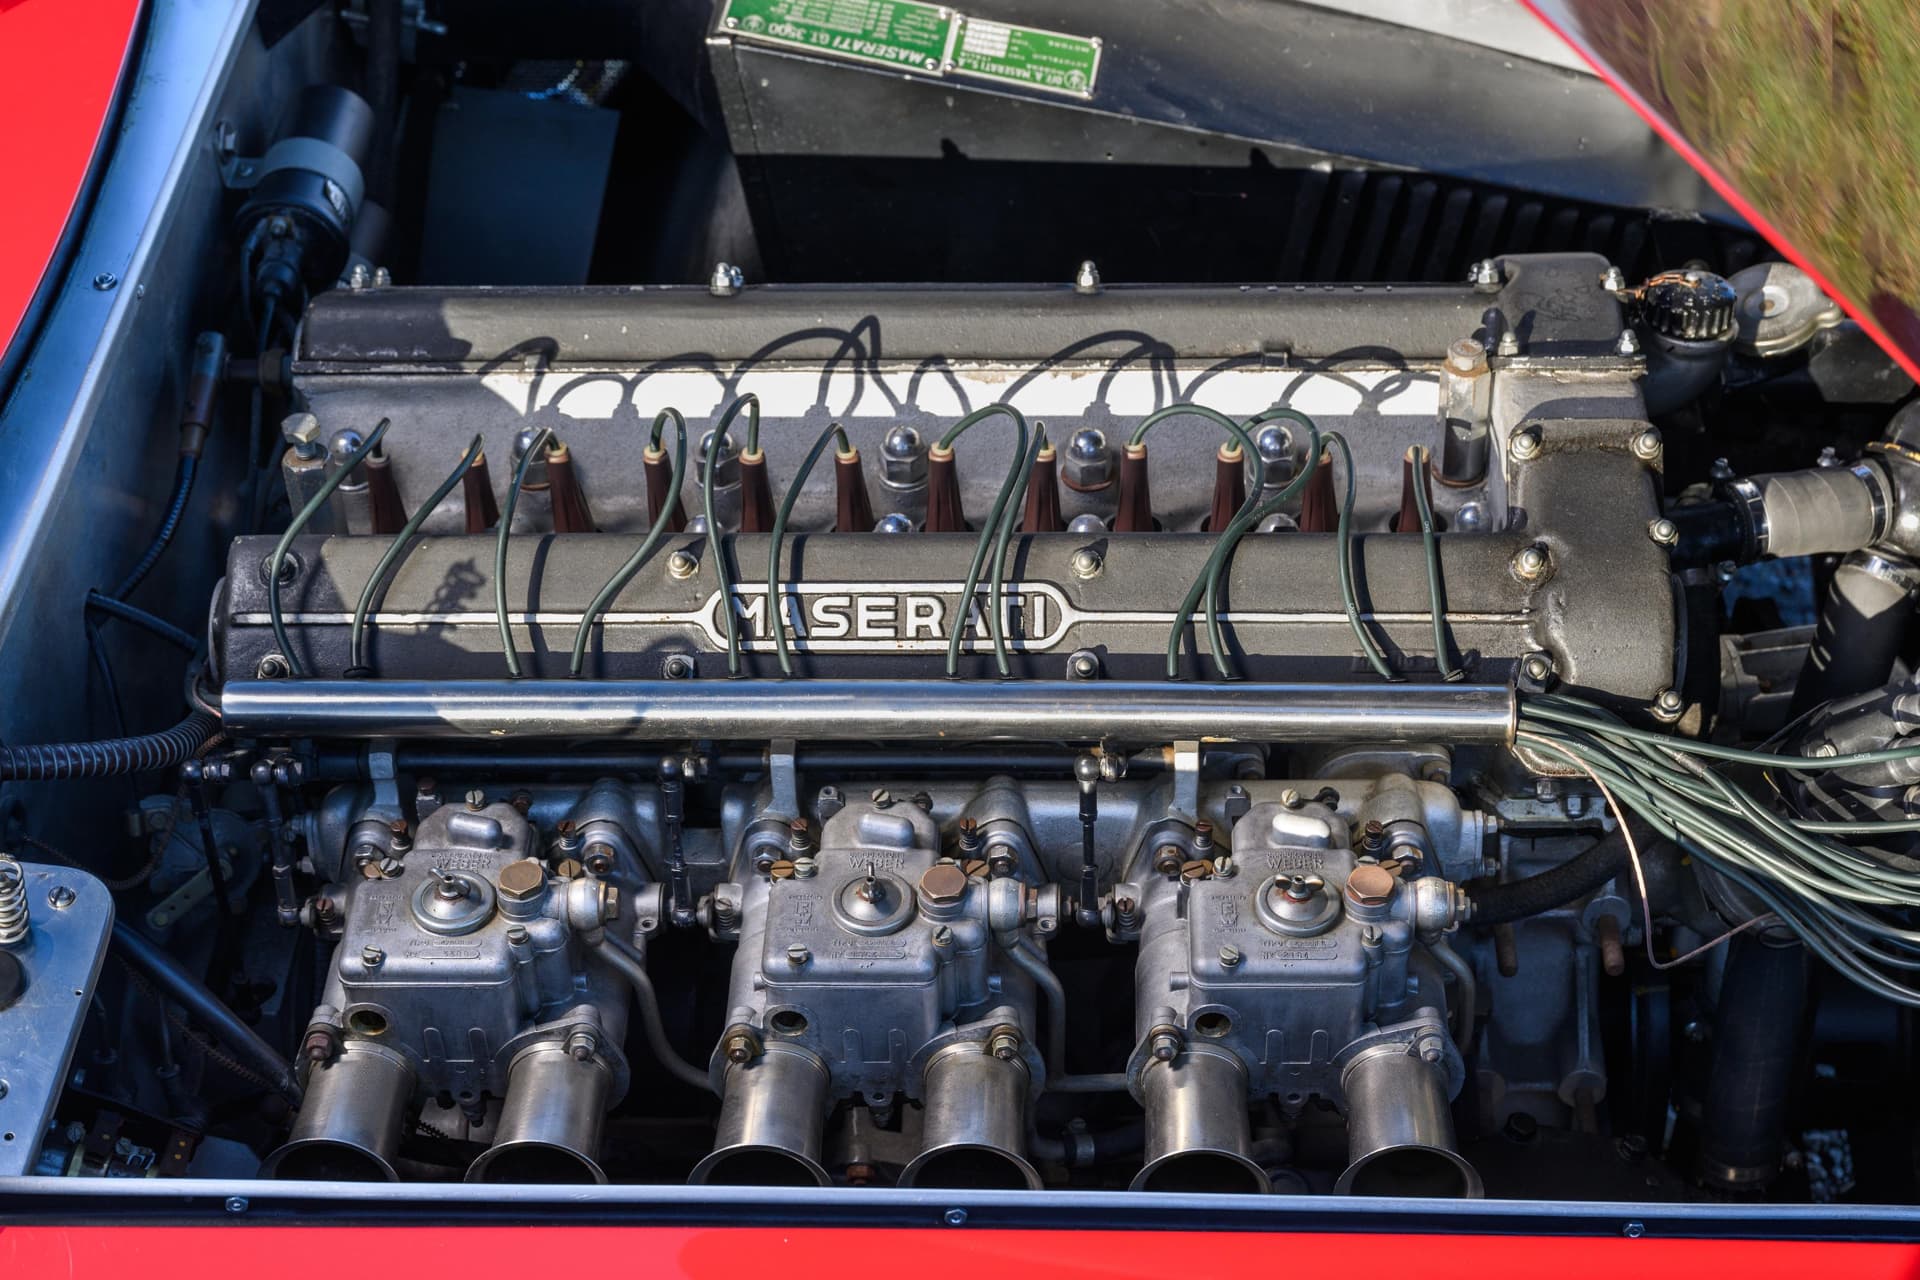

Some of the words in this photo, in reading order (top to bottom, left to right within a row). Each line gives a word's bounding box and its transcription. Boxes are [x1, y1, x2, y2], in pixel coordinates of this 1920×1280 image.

[768, 21, 807, 41] 3500
[831, 36, 925, 64] MASERATI
[981, 61, 1031, 79] MASERATI
[729, 594, 1046, 639] MASERATI
[436, 859, 491, 870] WEBER
[849, 858, 905, 870] WEBER
[1266, 858, 1324, 870] WEBER
